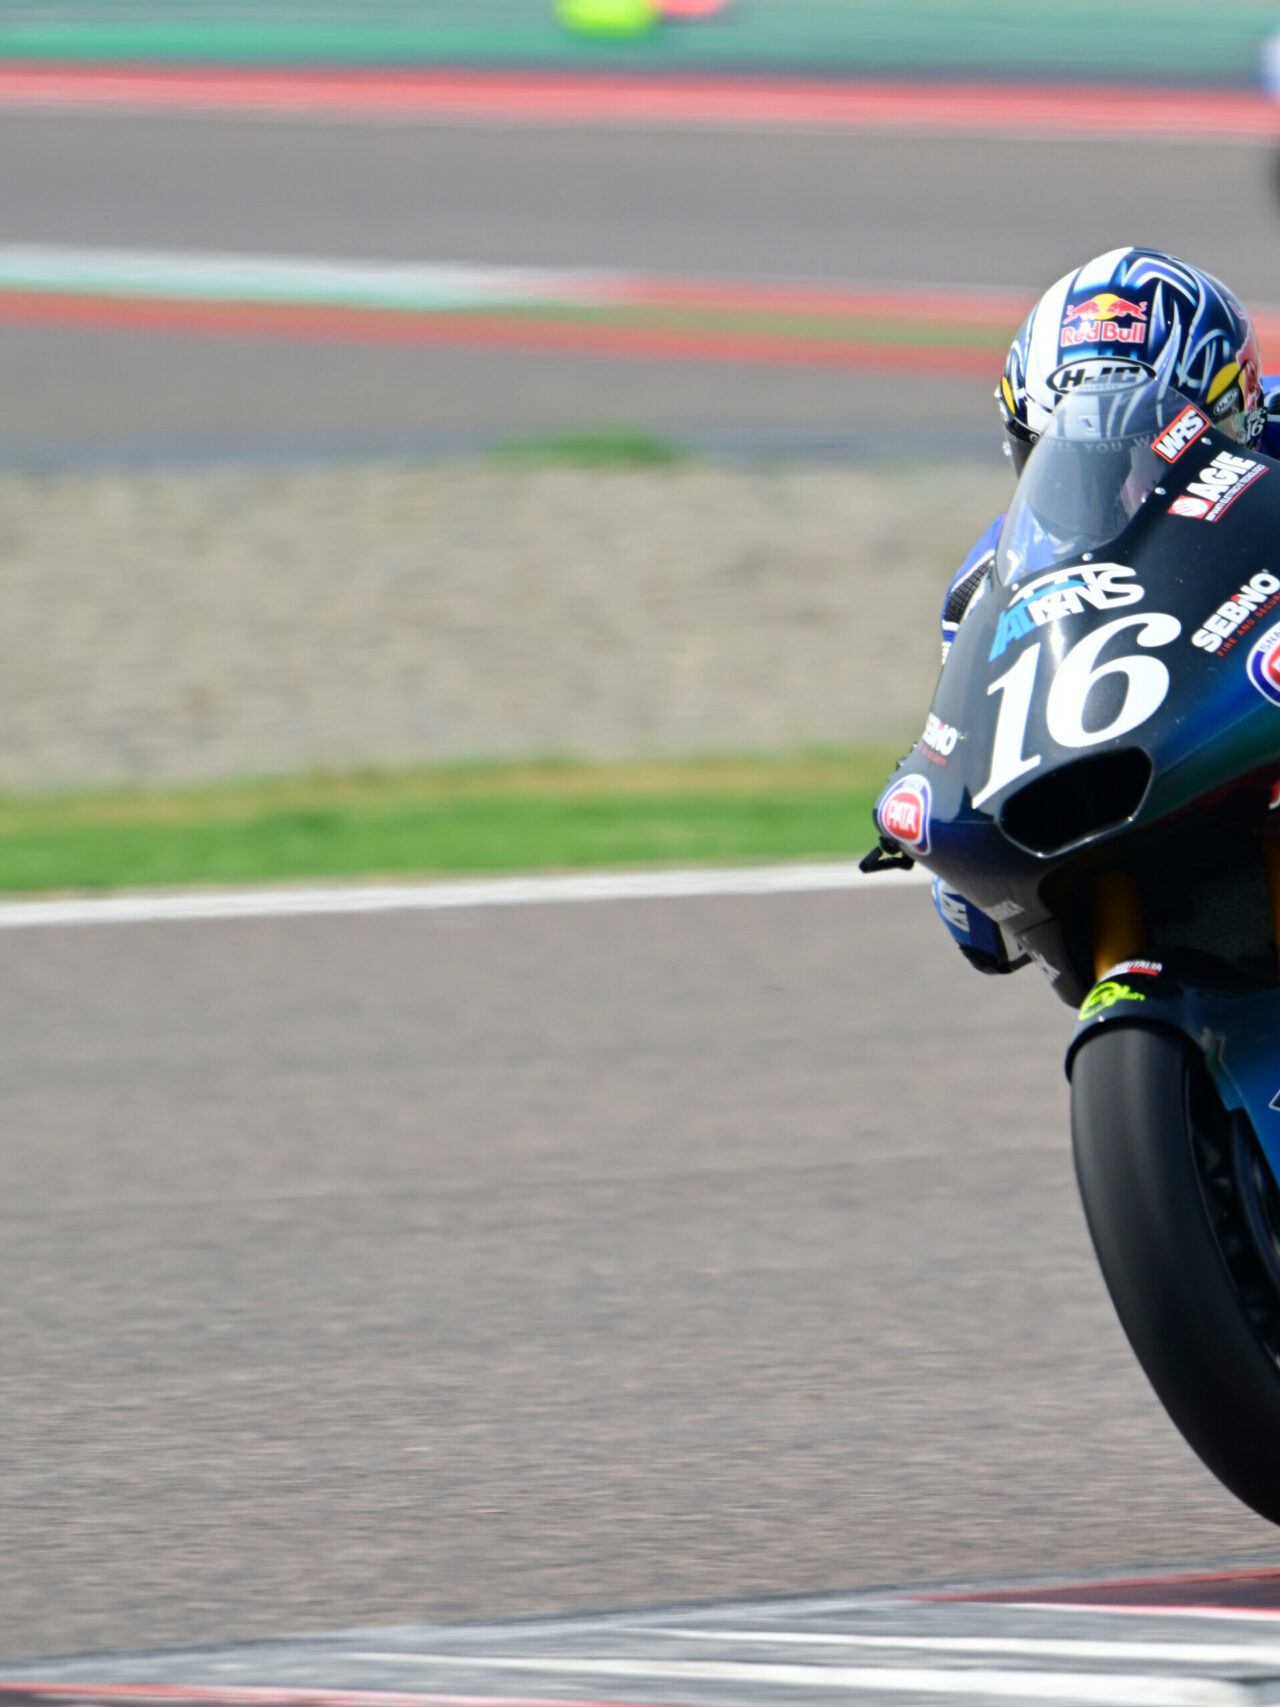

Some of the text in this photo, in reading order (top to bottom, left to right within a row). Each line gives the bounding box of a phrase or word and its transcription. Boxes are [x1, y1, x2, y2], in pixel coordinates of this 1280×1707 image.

[1061, 321, 1146, 347] Red Bull
[1059, 366, 1142, 389] HJC
[1156, 409, 1205, 460] WRS
[1187, 451, 1257, 503] AGIE
[1216, 637, 1238, 657] FIRE
[1236, 618, 1256, 637] AND
[971, 612, 1182, 809] 16
[887, 799, 917, 833] PATA
